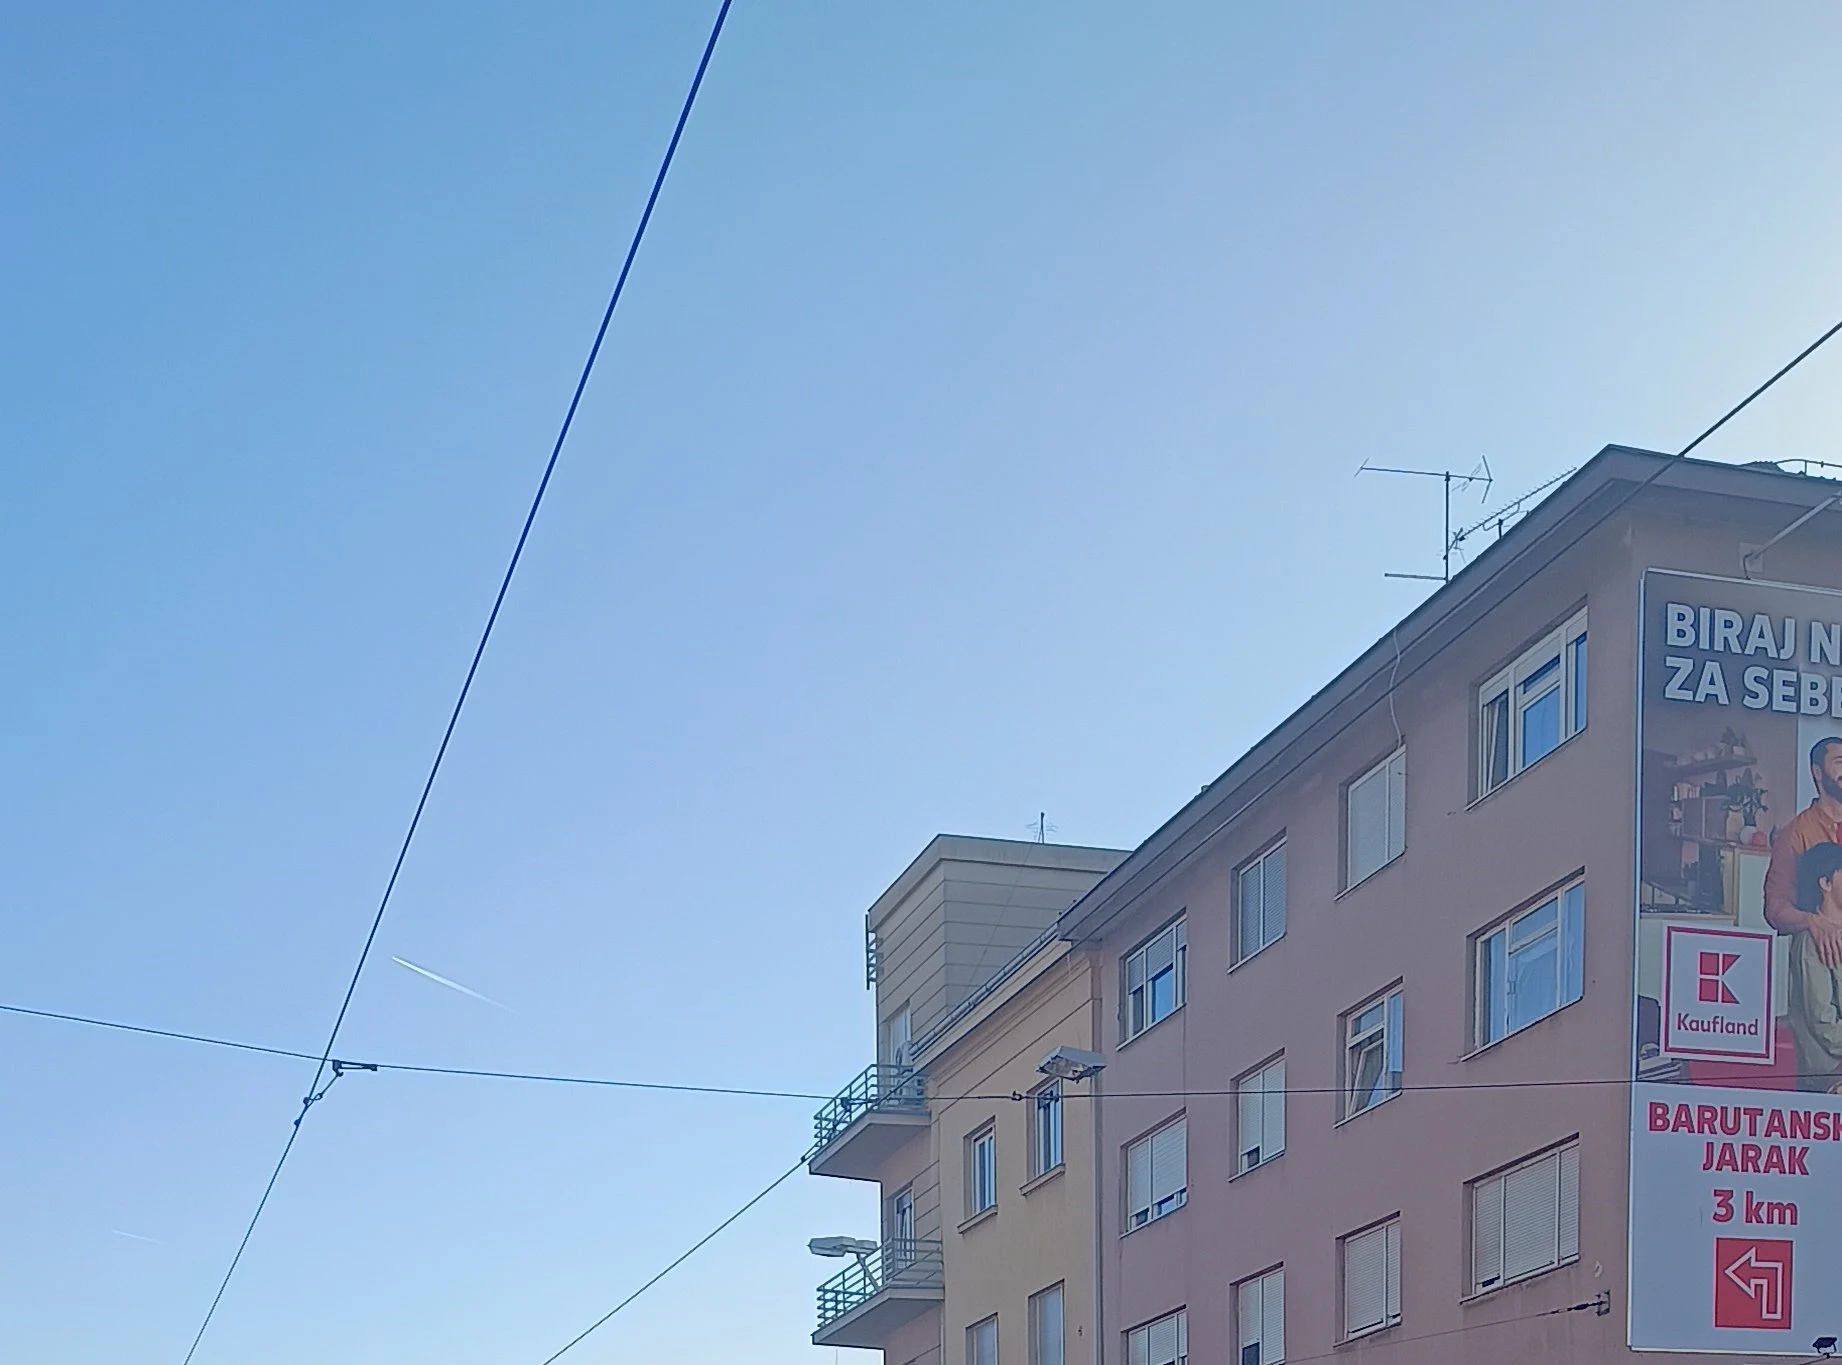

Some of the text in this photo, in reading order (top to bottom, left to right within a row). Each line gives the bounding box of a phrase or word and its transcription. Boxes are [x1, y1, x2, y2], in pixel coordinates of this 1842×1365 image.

[1666, 602, 1795, 660] BIRAJ
[1664, 656, 1730, 705] ZA
[1677, 1012, 1758, 1036] Kaufland
[1702, 1141, 1810, 1175] JARAK
[1713, 1188, 1798, 1225] 3 km
